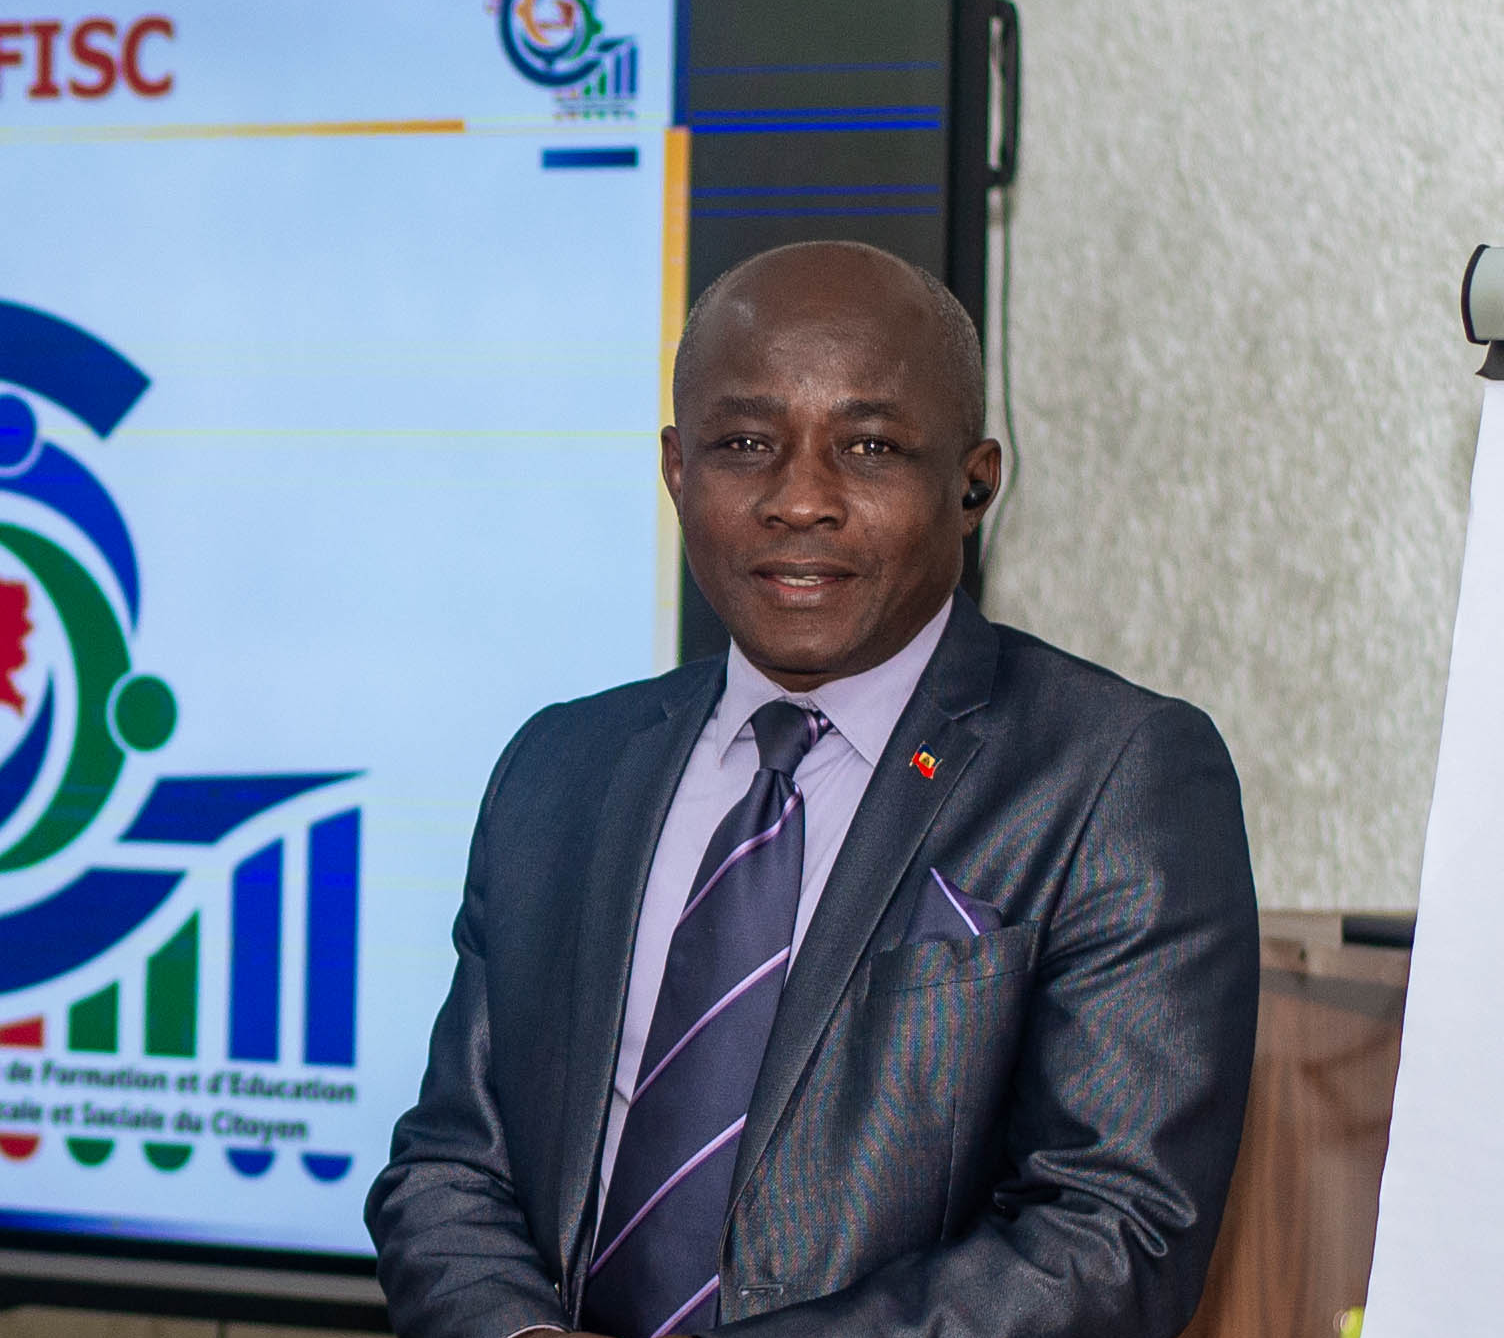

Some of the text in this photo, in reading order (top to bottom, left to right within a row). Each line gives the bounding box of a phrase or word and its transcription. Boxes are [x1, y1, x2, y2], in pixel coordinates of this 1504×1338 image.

[5, 1058, 34, 1084] de
[41, 1061, 167, 1093] Formation
[176, 1071, 200, 1094] et
[207, 1070, 357, 1103] d'Education
[51, 1102, 76, 1126] et
[81, 1103, 165, 1133] Sociale
[172, 1109, 203, 1134] du
[211, 1111, 308, 1145] Citoyen
